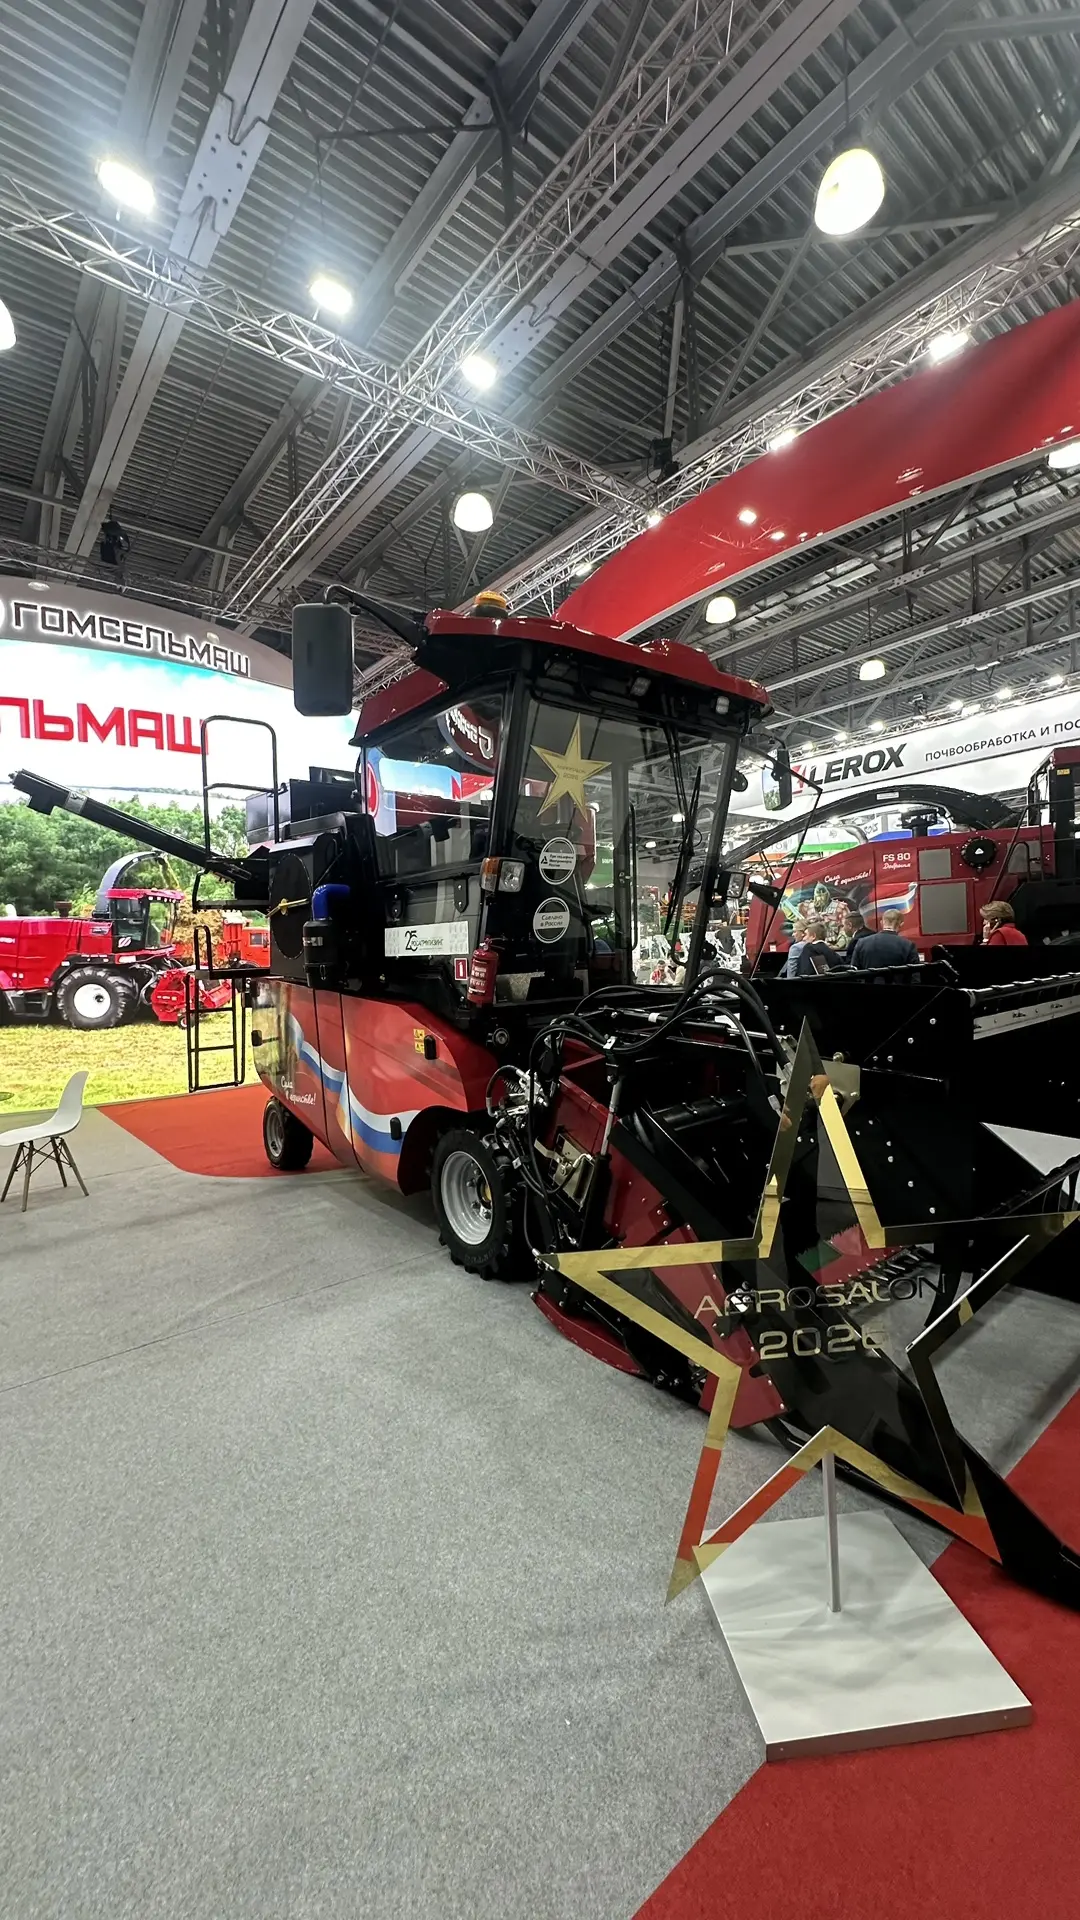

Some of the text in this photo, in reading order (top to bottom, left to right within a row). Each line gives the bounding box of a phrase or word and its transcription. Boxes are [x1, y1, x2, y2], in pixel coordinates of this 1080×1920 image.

[13, 602, 250, 677] ГОМСЕЛЬМАШ
[925, 729, 1036, 762] ПОЧВООБРАБОТКА
[1040, 726, 1050, 736] И
[882, 852, 911, 862] FS 80
